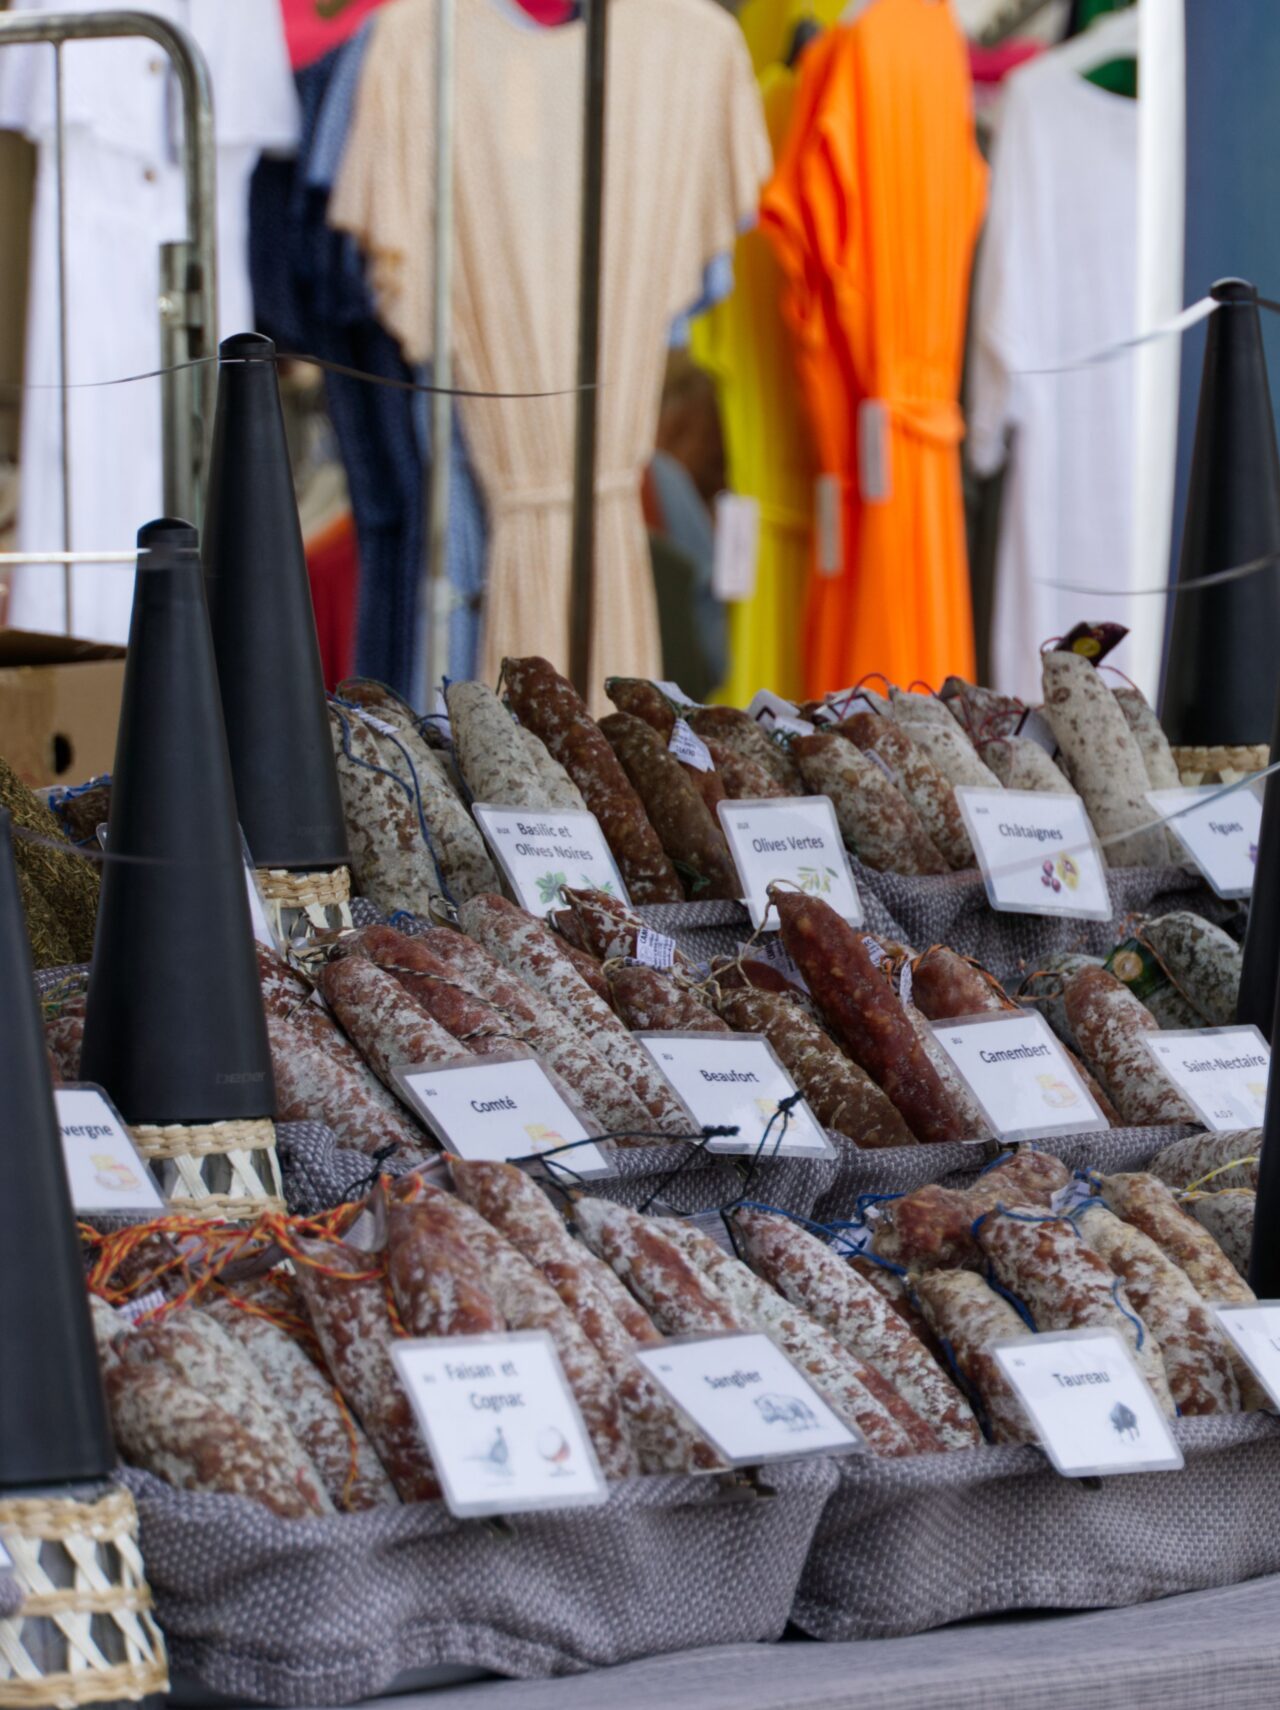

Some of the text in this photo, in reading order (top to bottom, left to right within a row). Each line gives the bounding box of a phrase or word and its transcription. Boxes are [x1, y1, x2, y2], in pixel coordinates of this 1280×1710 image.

[516, 822, 558, 838] Basilic
[559, 825, 573, 838] et
[999, 822, 1064, 841] Châtaignes
[515, 843, 594, 861] Olives Noires
[752, 836, 825, 854] Olives Vertes
[979, 1043, 1052, 1064] Camembert
[1182, 1054, 1268, 1073] Saint-Nectaire
[700, 1069, 760, 1083] Beaufort
[470, 1095, 518, 1113] Comté
[444, 1361, 497, 1381] Faisan
[1052, 1370, 1112, 1388] Taureau
[469, 1391, 527, 1414] Cognac
